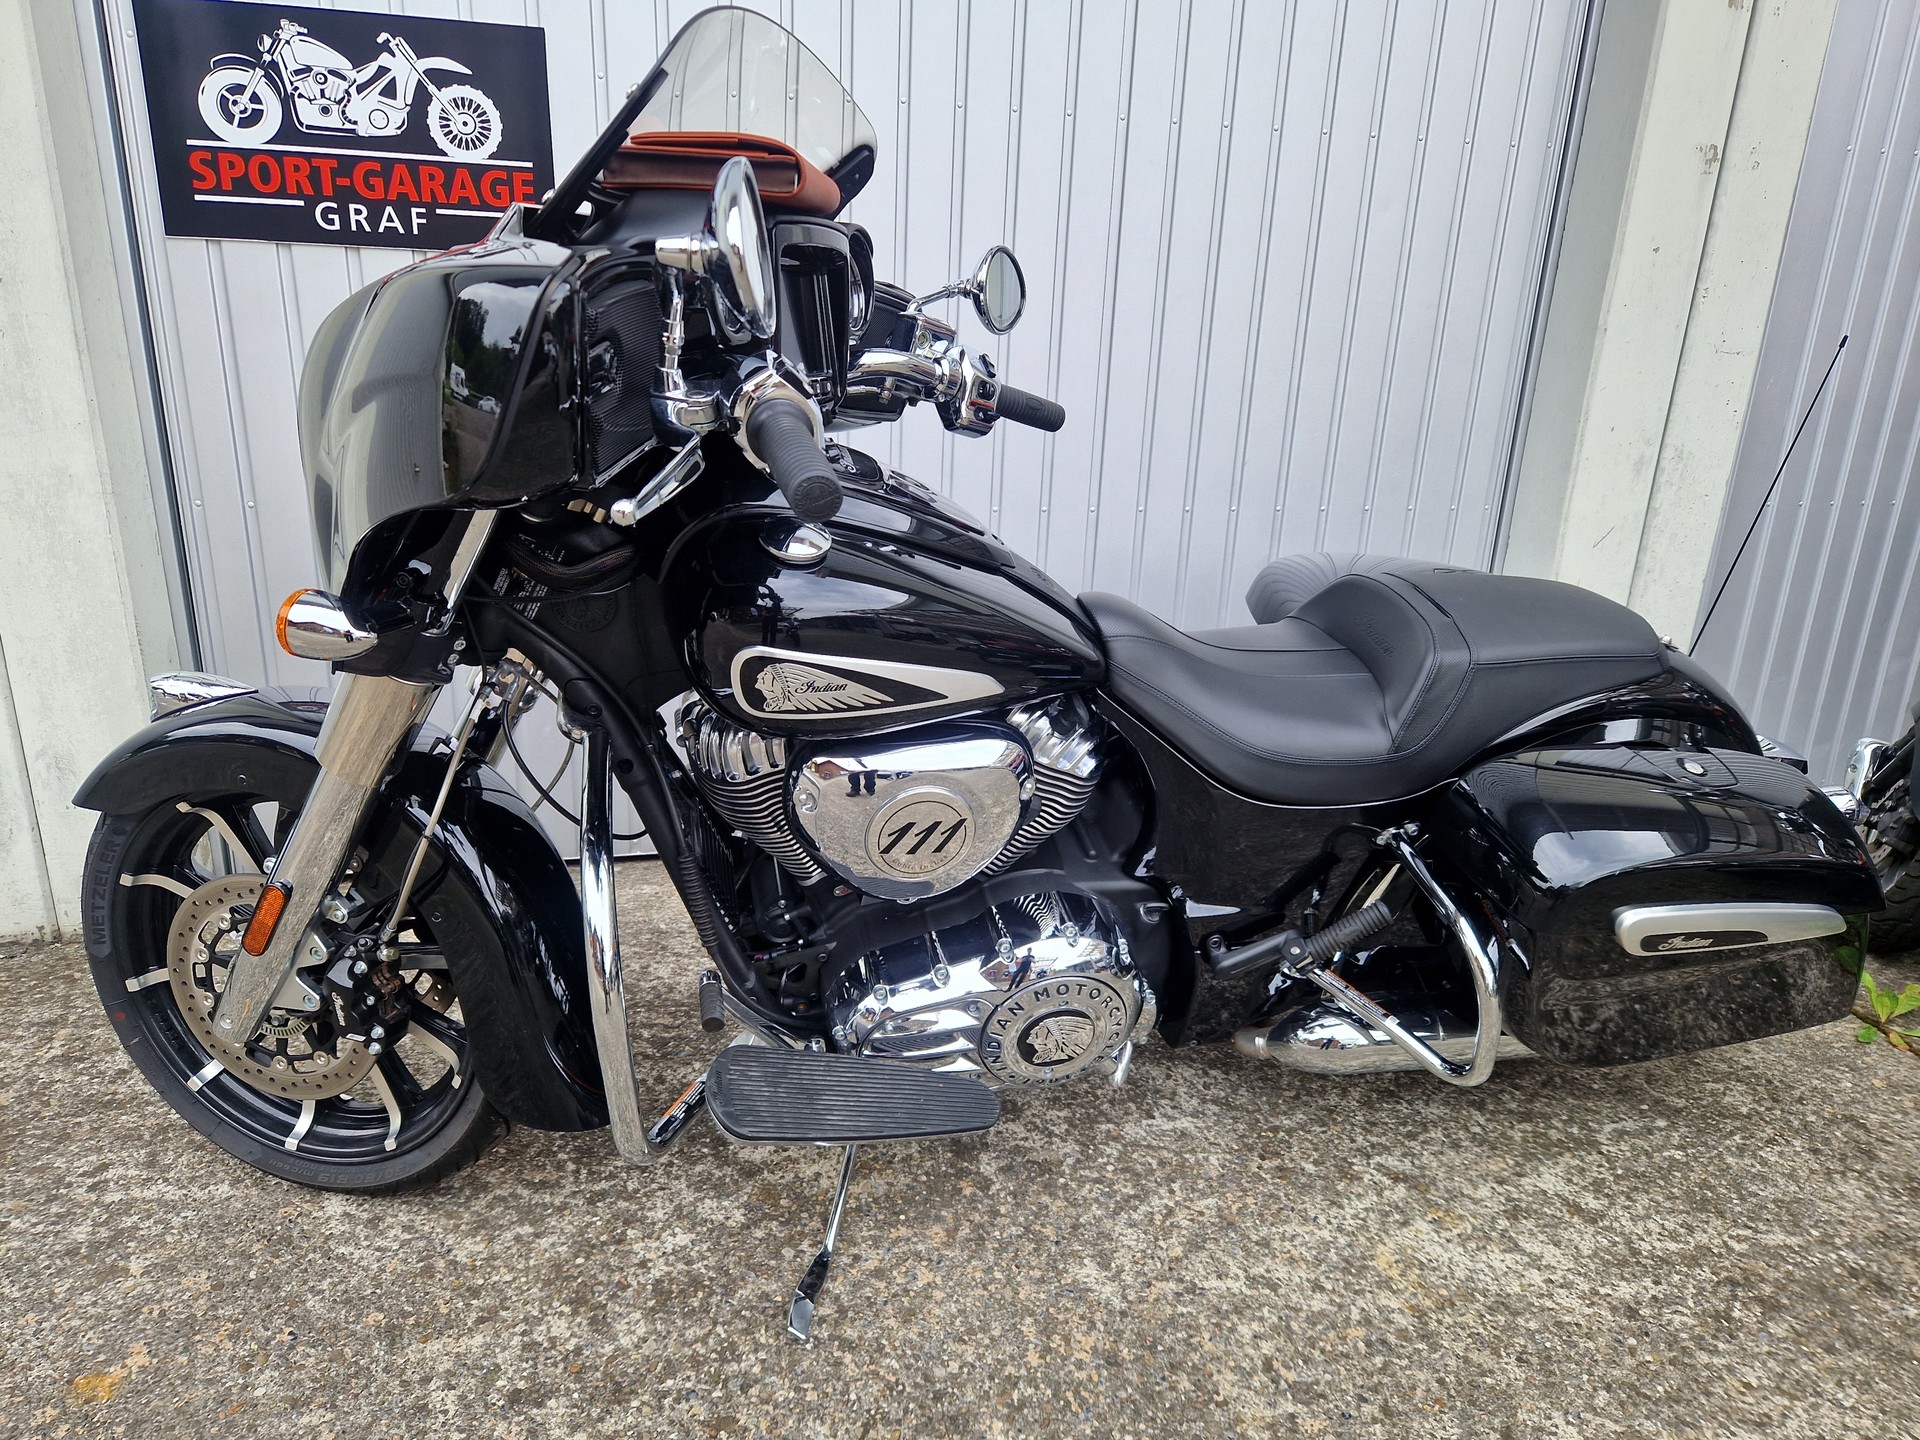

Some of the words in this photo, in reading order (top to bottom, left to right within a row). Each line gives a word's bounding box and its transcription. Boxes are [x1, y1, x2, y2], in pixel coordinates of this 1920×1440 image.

[188, 151, 537, 207] SPORT-GARAGE
[314, 202, 428, 236] GRAF
[795, 680, 848, 694] Indian
[879, 817, 968, 854] 111
[91, 839, 121, 946] METZELER
[1658, 935, 1713, 951] Indian
[331, 991, 346, 1028] Indian
[986, 1002, 1025, 1072] INDIAN
[712, 1069, 724, 1105] Indian
